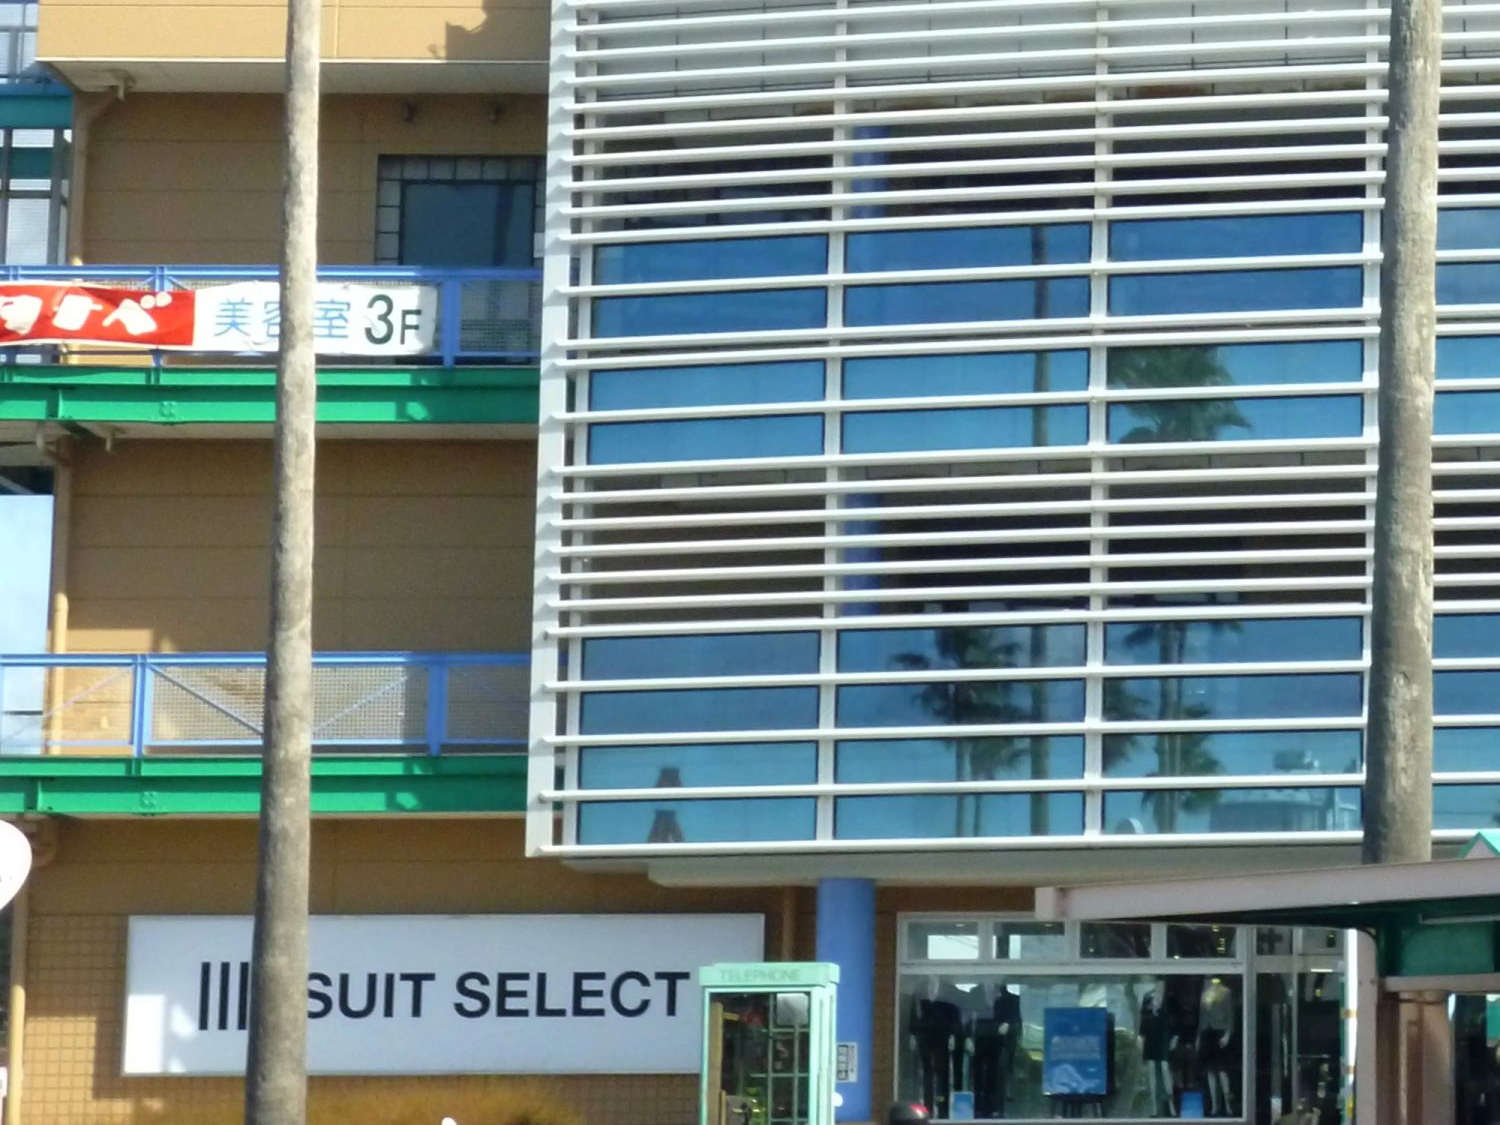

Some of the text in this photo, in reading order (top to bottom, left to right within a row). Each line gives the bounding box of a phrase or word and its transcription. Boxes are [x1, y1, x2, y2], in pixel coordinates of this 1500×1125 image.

[364, 294, 422, 345] 3F
[305, 971, 690, 1018] SUIT SELECT
